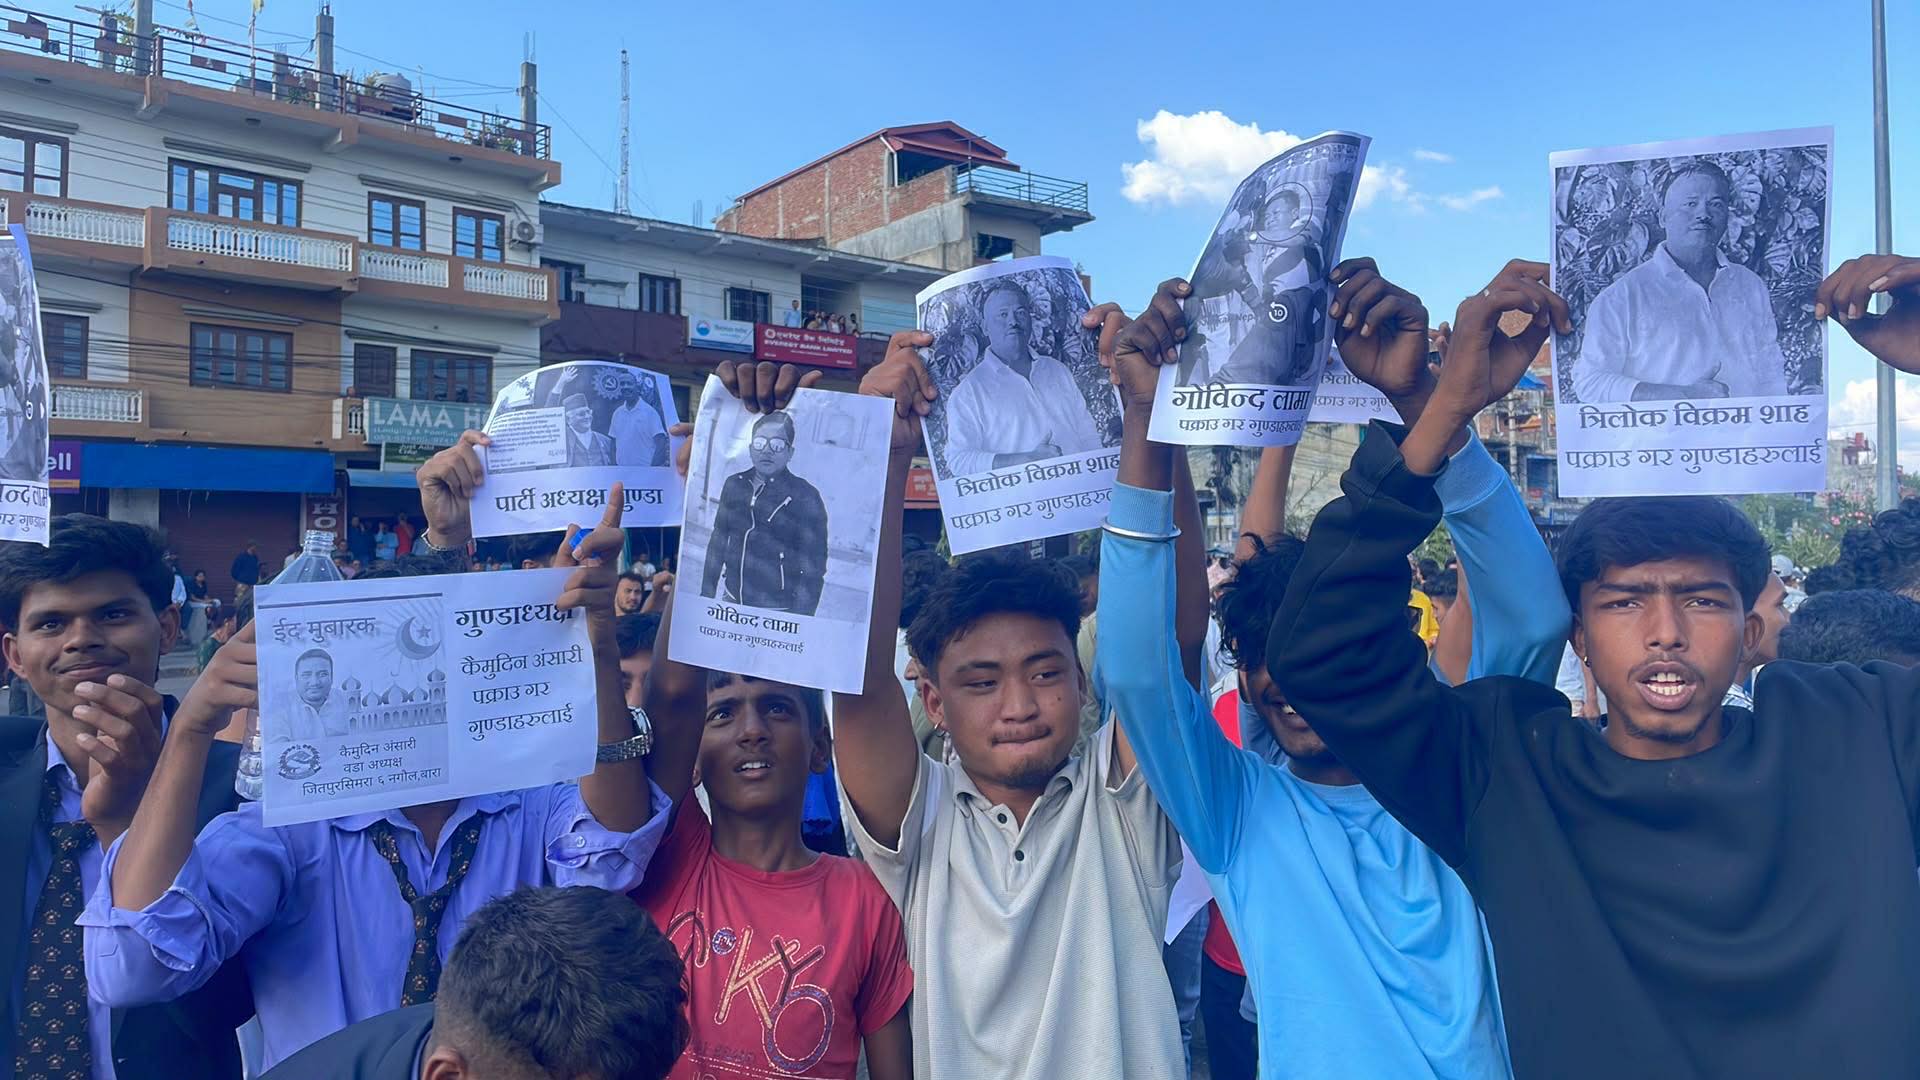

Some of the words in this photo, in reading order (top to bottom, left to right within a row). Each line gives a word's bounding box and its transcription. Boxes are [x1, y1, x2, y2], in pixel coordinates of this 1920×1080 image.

[764, 339, 798, 349] EVEREST
[800, 343, 821, 351] BANK
[823, 345, 853, 355] LIMITED
[1172, 381, 1268, 411] गोविन्द
[1273, 389, 1311, 411] लामा
[1348, 395, 1368, 407] गर
[374, 400, 454, 428] LAMA
[464, 407, 488, 430] H
[1179, 417, 1219, 432] पक्राउ
[1223, 417, 1246, 432] गर
[1579, 403, 1667, 428] त्रिलोक
[1673, 401, 1752, 426] विक्रम
[1759, 403, 1810, 425] शाह
[1566, 449, 1632, 470] पक्राउ
[1638, 448, 1674, 467] गर
[1680, 438, 1822, 474] गुण्डाहरुलाई
[955, 472, 1021, 497] त्रिलोक
[1025, 462, 1083, 484] विक्रम
[496, 487, 536, 512] पार्टी
[540, 488, 608, 508] अध्यक्ष
[951, 507, 1001, 531] पक्राउ
[1005, 501, 1032, 519] गर
[273, 617, 300, 642] ईद
[307, 617, 376, 643] मुबारक
[455, 603, 573, 638] गुण्डाध्यक्ष
[707, 603, 760, 628] गोविन्द
[763, 617, 800, 634] लामा
[728, 631, 744, 642] गर
[461, 652, 528, 680] कैमुदिन
[532, 644, 583, 668] अंसारी
[472, 685, 520, 704] पक्राउ
[524, 681, 550, 696] गर
[468, 703, 573, 741] गुण्डाहरुलाई
[339, 741, 379, 760] कैमुदिन
[383, 737, 416, 752] अंसारी
[343, 761, 364, 774] वडा
[368, 757, 402, 771] अध्यक्ष
[302, 776, 372, 796] जितपुरसिमरा
